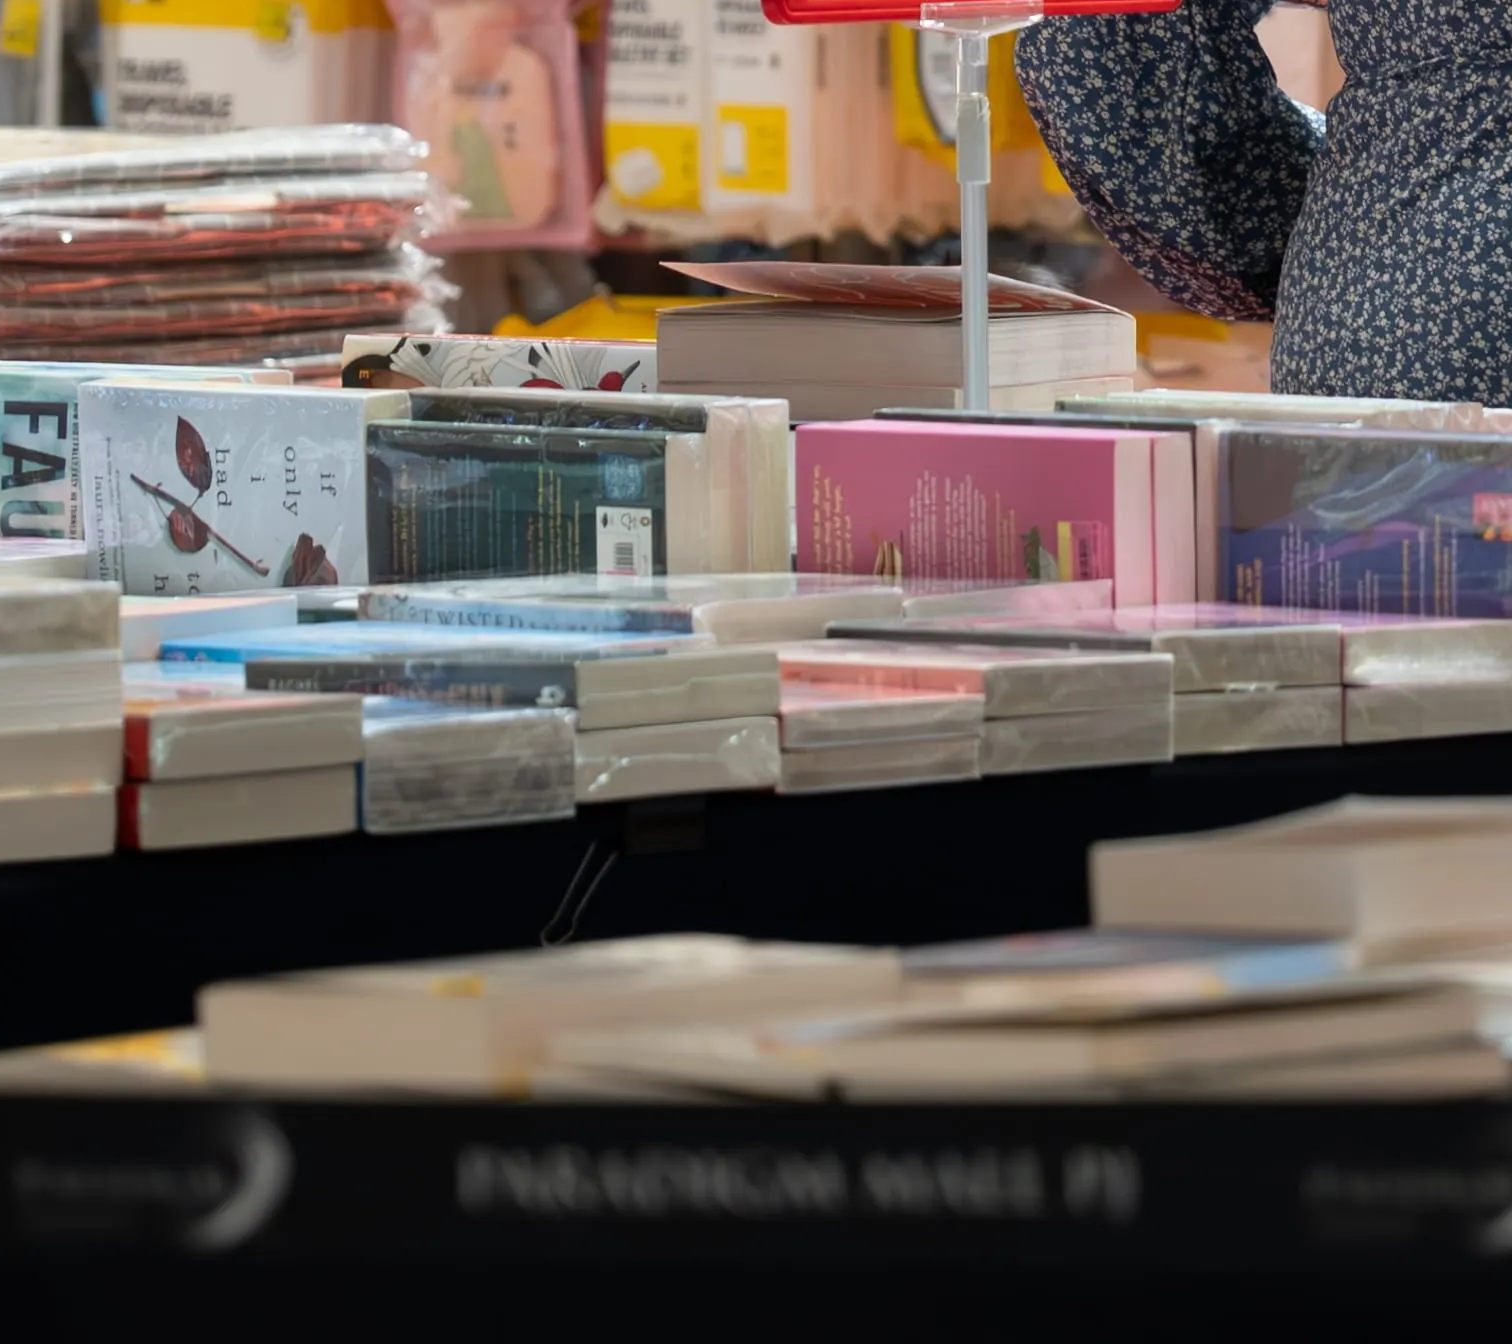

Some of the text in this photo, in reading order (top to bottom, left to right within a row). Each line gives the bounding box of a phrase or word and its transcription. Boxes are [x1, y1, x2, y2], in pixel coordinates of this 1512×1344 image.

[0, 400, 69, 539] FAU
[215, 448, 232, 508] had
[283, 446, 301, 516] only
[319, 472, 336, 497] if
